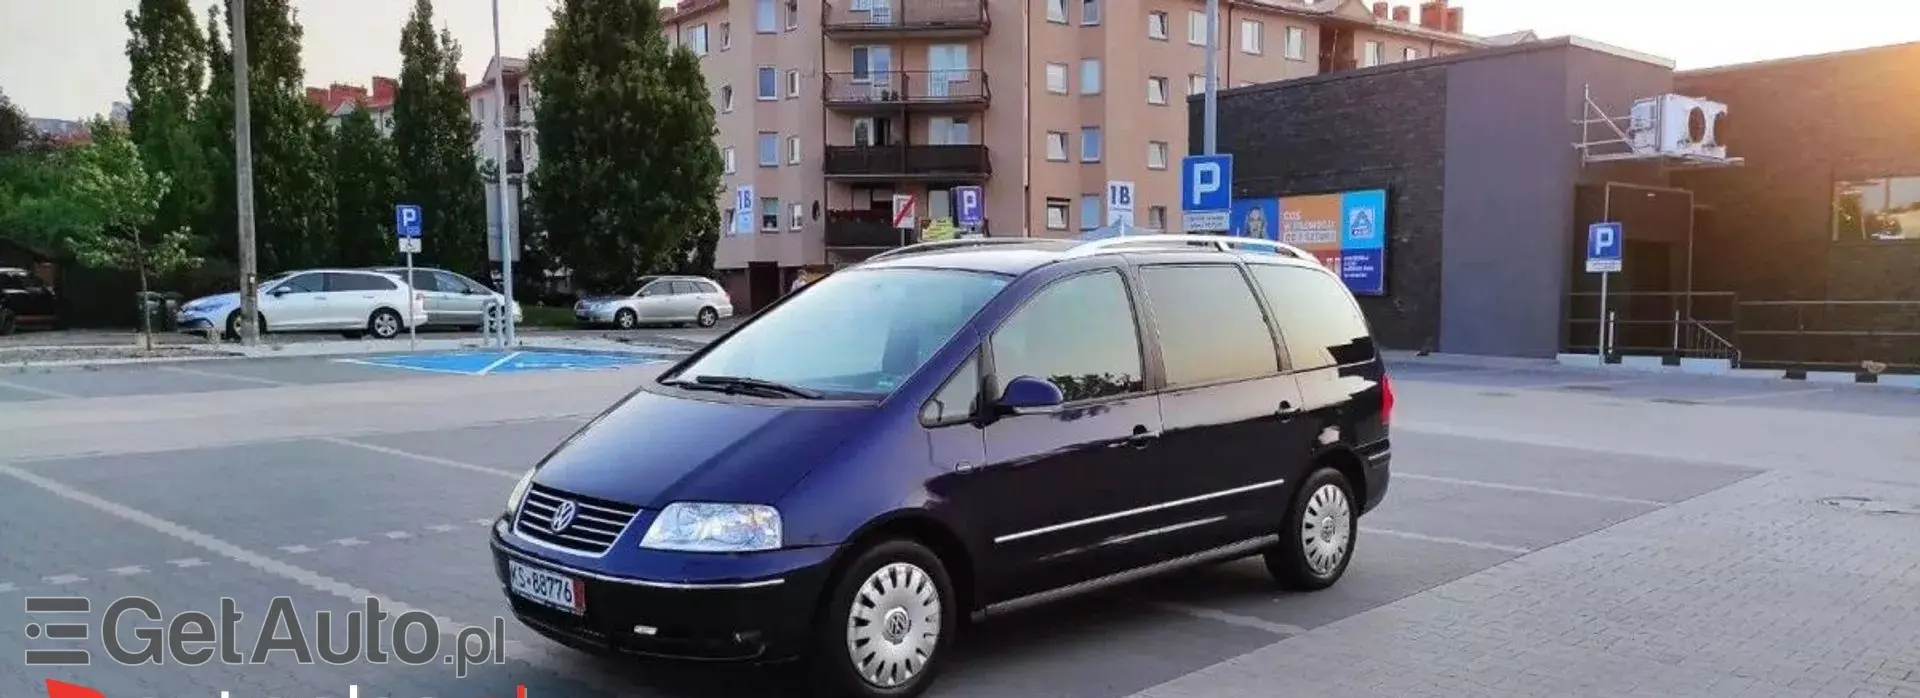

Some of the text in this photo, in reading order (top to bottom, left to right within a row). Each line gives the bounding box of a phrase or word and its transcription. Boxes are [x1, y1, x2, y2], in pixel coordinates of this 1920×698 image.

[1110, 185, 1131, 206] 1B
[1193, 162, 1221, 205] P
[963, 190, 977, 216] P
[402, 208, 417, 227] P
[1596, 227, 1614, 255] P
